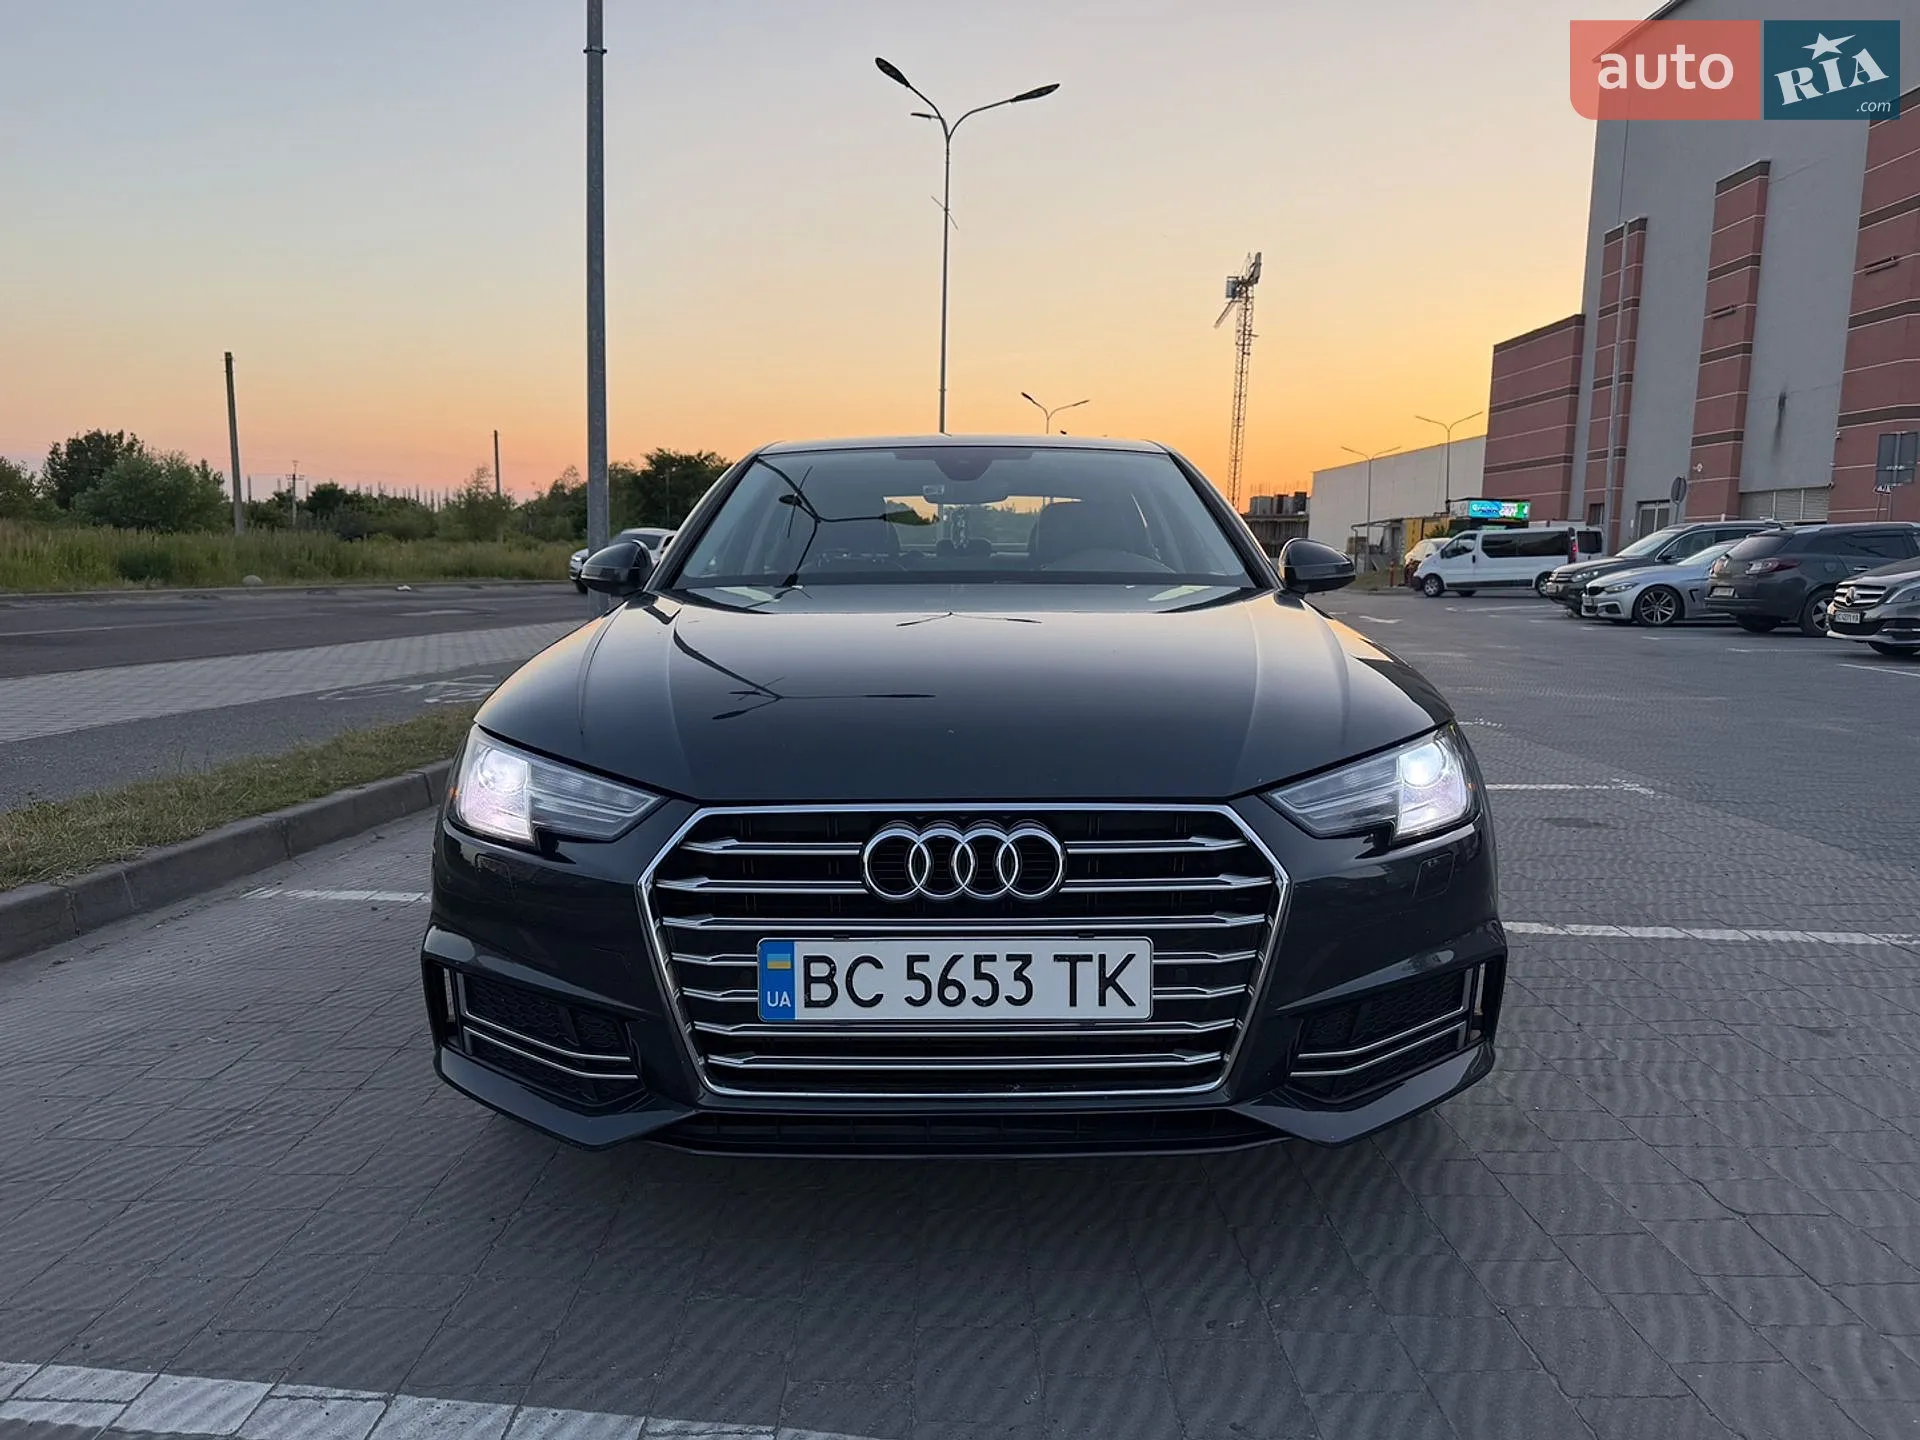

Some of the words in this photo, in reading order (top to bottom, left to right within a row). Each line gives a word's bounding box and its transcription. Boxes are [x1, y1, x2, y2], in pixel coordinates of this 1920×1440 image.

[803, 954, 884, 1008] BC
[904, 953, 1034, 1008] 5653
[1053, 953, 1136, 1007] TK
[767, 992, 791, 1008] UA
